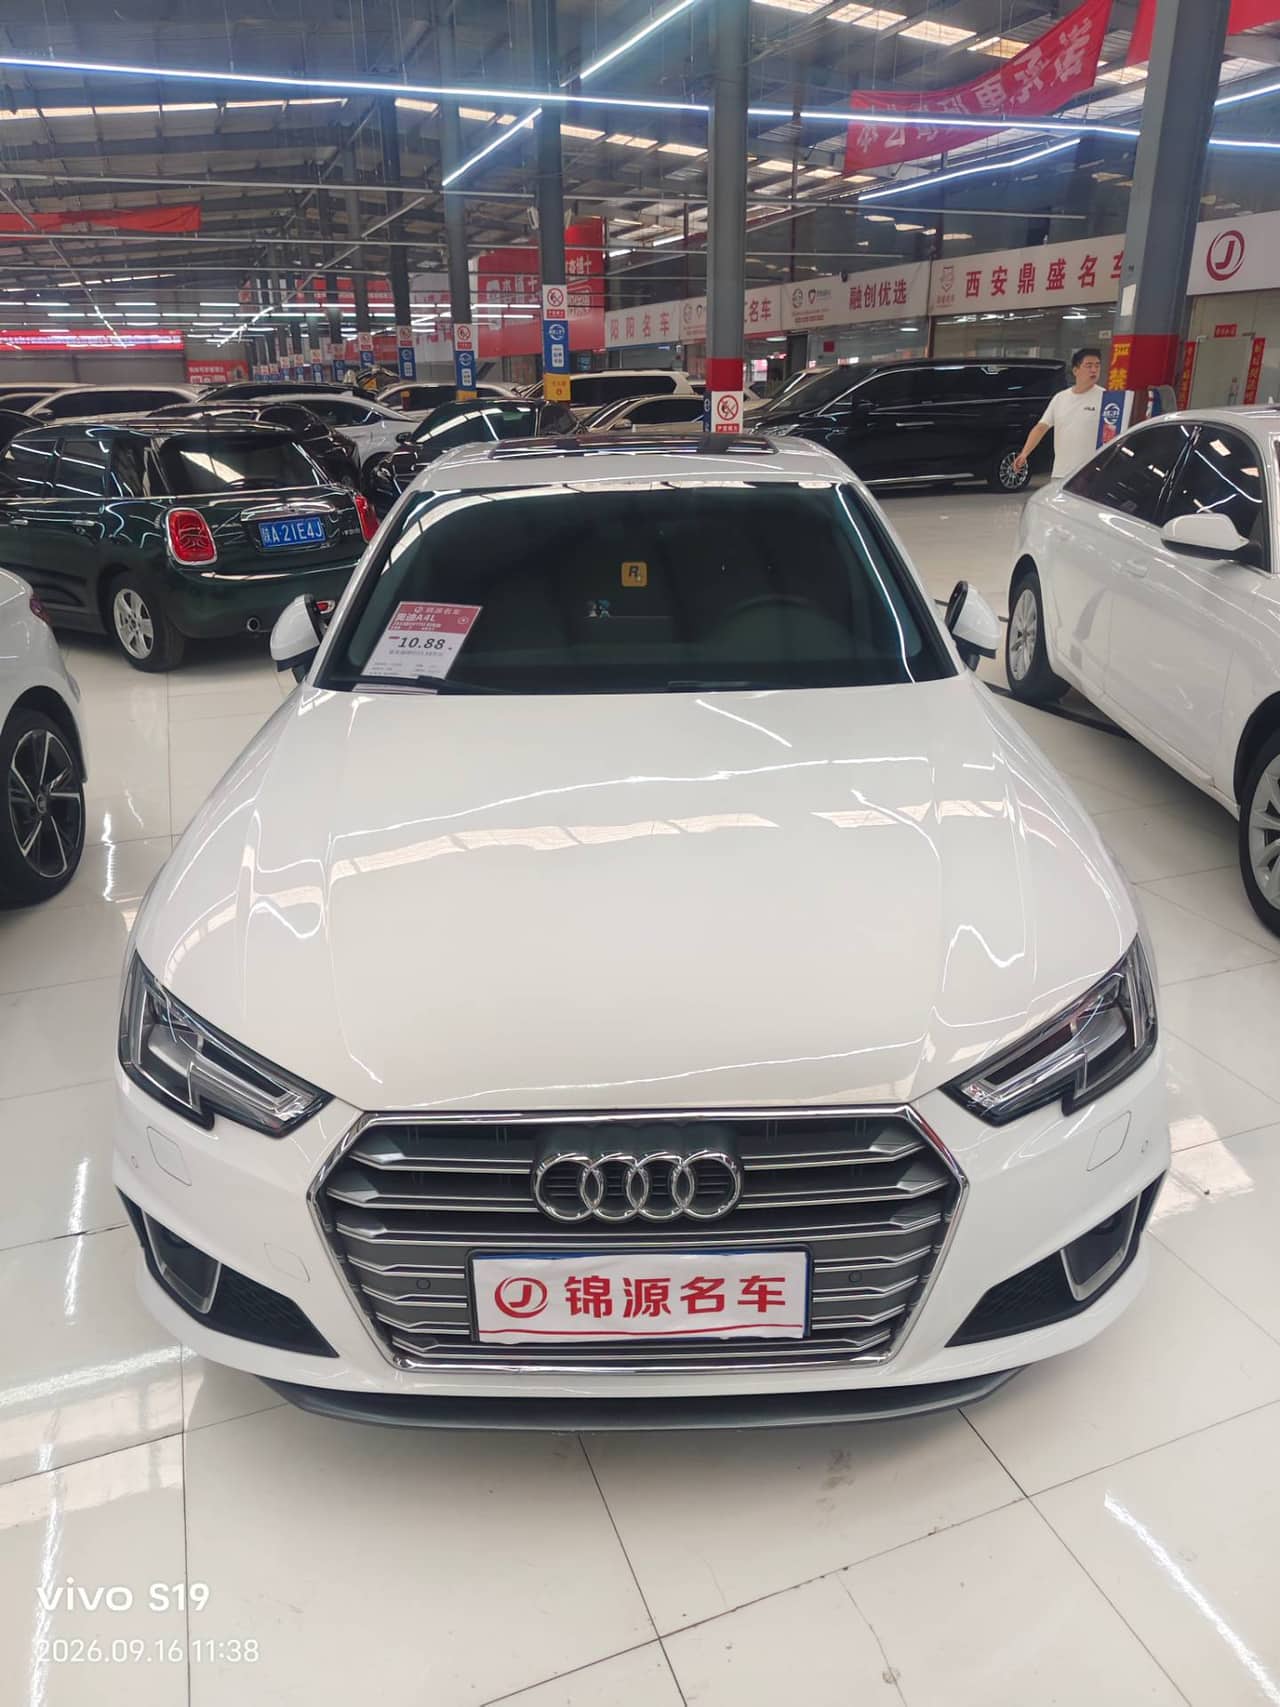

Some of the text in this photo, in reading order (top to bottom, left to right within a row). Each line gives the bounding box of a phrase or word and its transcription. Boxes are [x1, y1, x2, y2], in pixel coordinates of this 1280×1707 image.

[849, 279, 907, 310] 融创优选
[1108, 343, 1131, 390] 严禁
[398, 637, 446, 650] 10.88
[564, 1275, 786, 1318] 锦源名车
